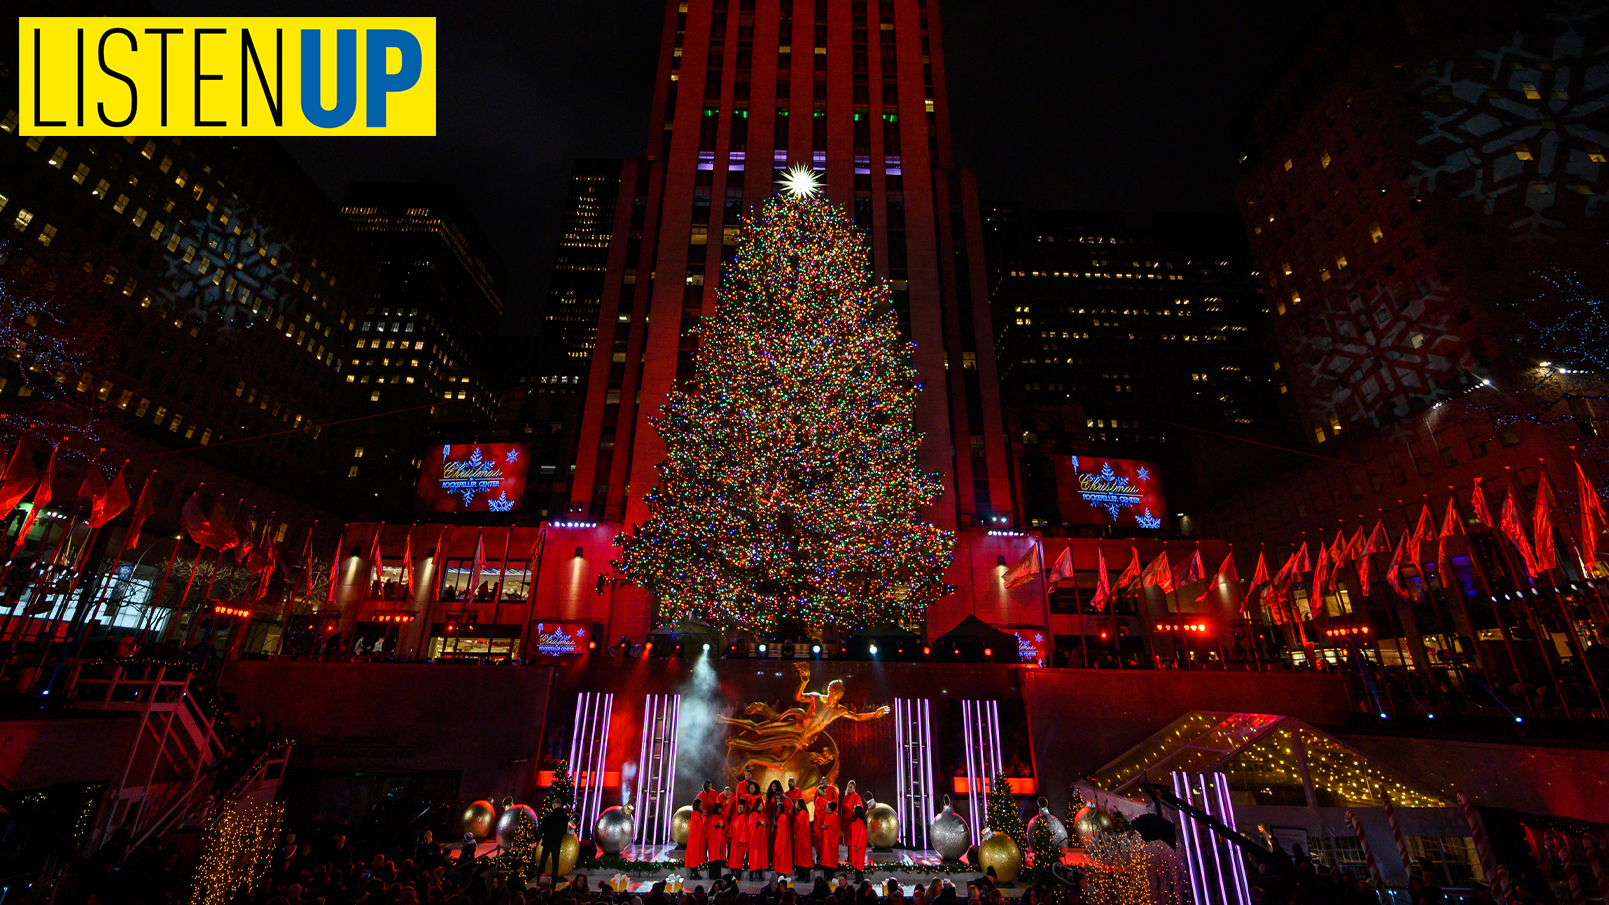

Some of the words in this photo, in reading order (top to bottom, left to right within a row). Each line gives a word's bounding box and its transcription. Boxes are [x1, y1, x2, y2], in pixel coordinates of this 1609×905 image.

[443, 461, 504, 479] Christmas
[1078, 473, 1140, 494] Christmas
[1082, 494, 1118, 502] ROCKEFELLER
